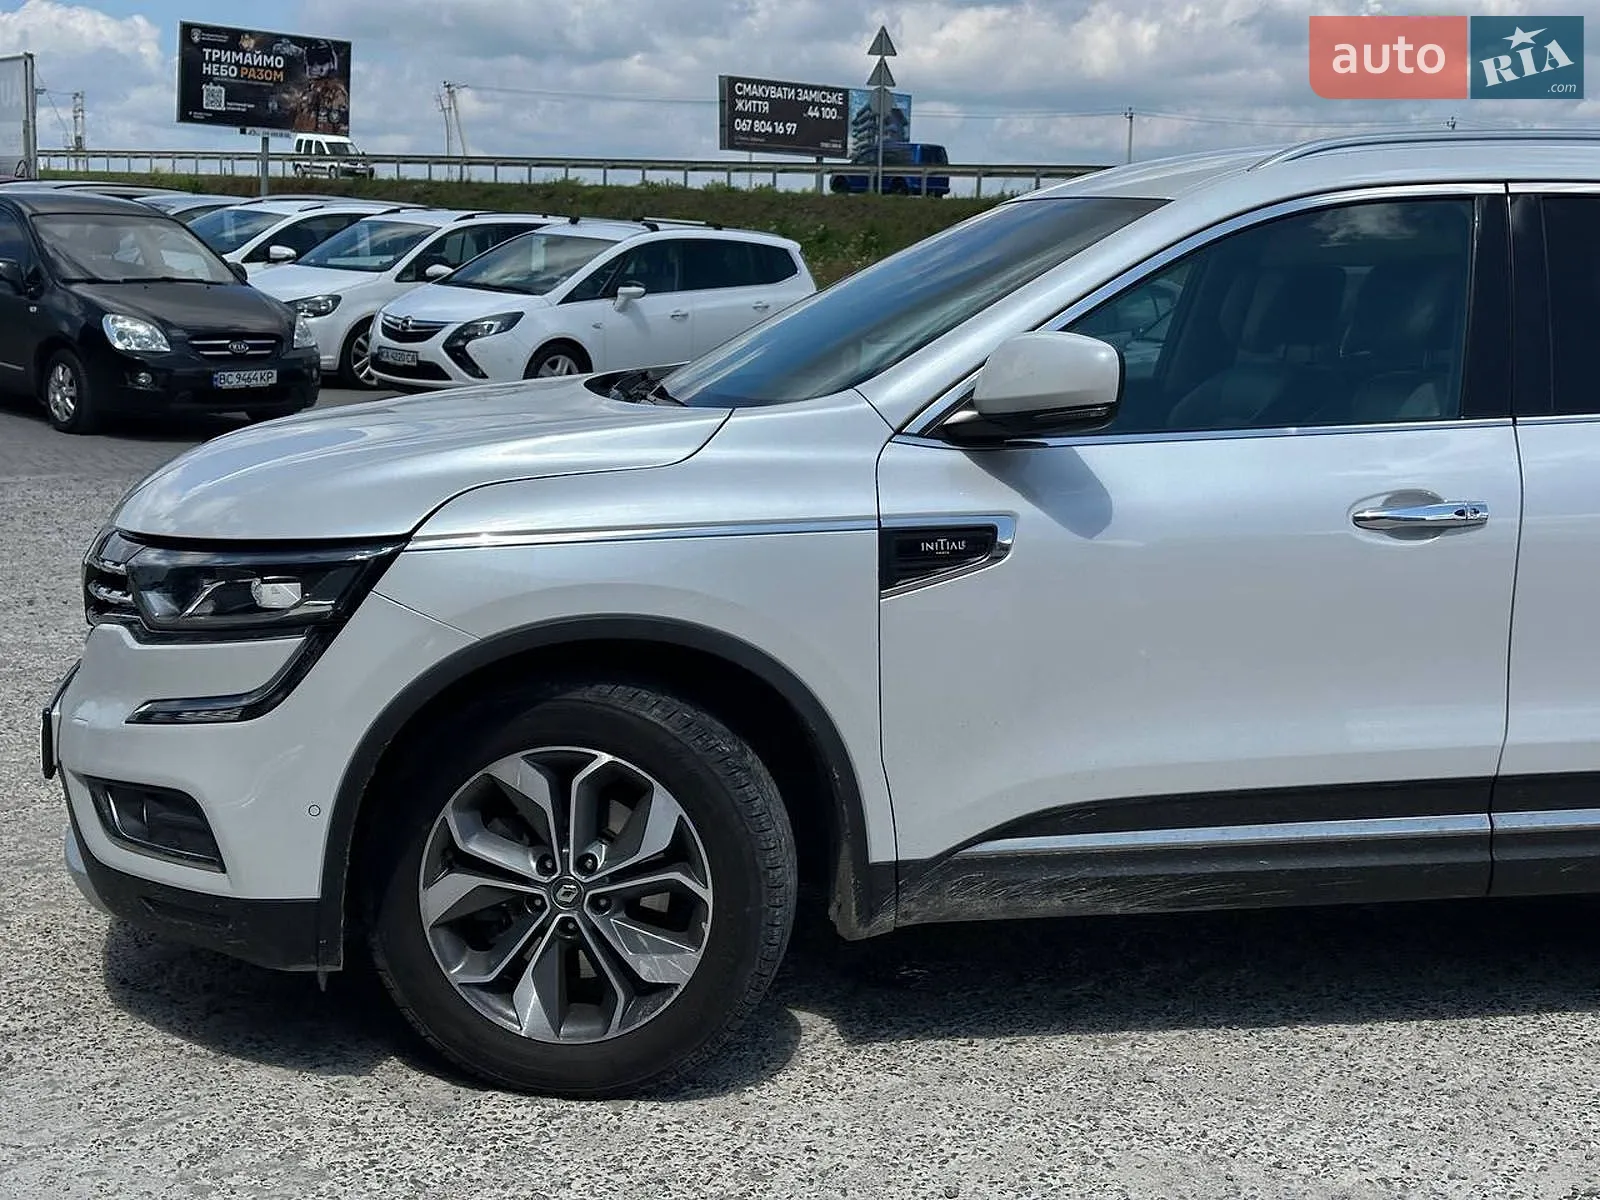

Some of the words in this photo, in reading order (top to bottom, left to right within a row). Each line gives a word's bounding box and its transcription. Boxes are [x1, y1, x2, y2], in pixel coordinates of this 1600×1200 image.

[202, 47, 284, 69] ТРИМАЙМО
[202, 62, 238, 78] НЕБО
[240, 66, 284, 82] РАЗОМ
[734, 82, 795, 100] СМАКУВАТИ
[796, 88, 844, 105] ЗАМІСЬКЕ
[734, 98, 769, 114] ЖИТТЯ
[807, 105, 820, 119] 44
[821, 107, 837, 120] 100
[734, 118, 752, 132] 067
[753, 120, 773, 133] 804
[774, 122, 785, 134] 16
[786, 122, 798, 135] 97
[236, 371, 259, 384] 9464
